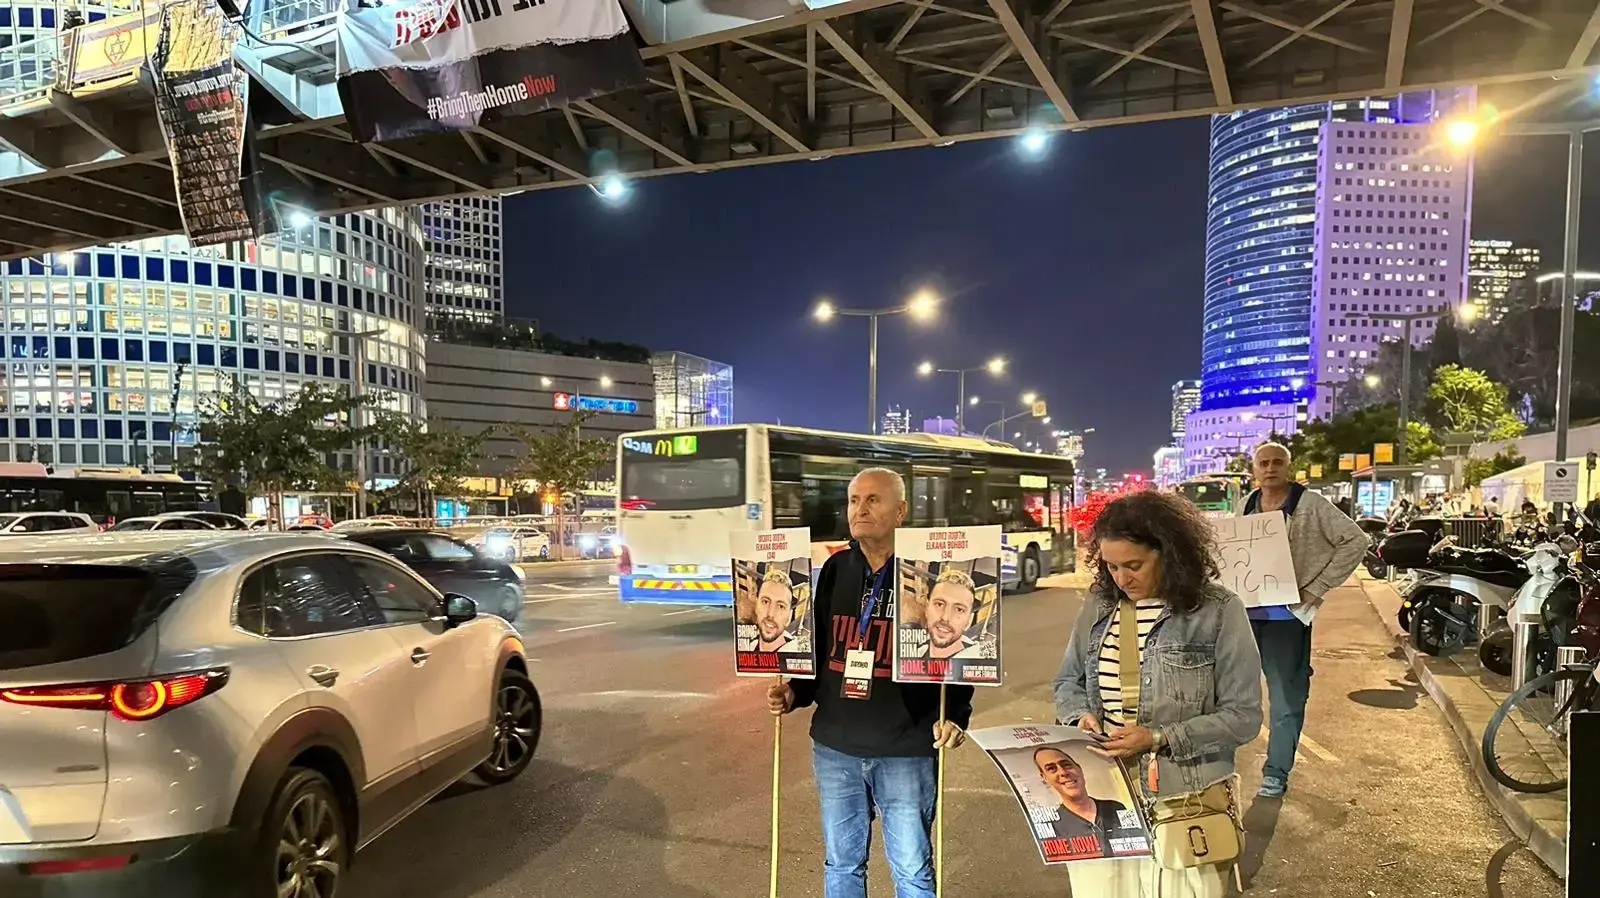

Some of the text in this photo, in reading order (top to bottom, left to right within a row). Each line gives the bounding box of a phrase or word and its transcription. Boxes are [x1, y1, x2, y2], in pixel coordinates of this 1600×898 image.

[426, 74, 557, 121] #BringThemHomeNow
[755, 543, 771, 552] ELKANA
[926, 540, 969, 550] ELKANA BOHBOT
[737, 624, 758, 639] BRING
[900, 628, 927, 643] BRING
[737, 638, 750, 652] HIM
[900, 643, 919, 658] HIM
[738, 653, 758, 667] HOME
[759, 652, 780, 667] NOW!
[900, 659, 926, 674] HOME
[928, 660, 953, 674] NOW!
[1028, 807, 1061, 824] BRING
[1033, 822, 1057, 839] HIM
[1041, 838, 1071, 856] HOME
[1069, 833, 1102, 853] NOW!
